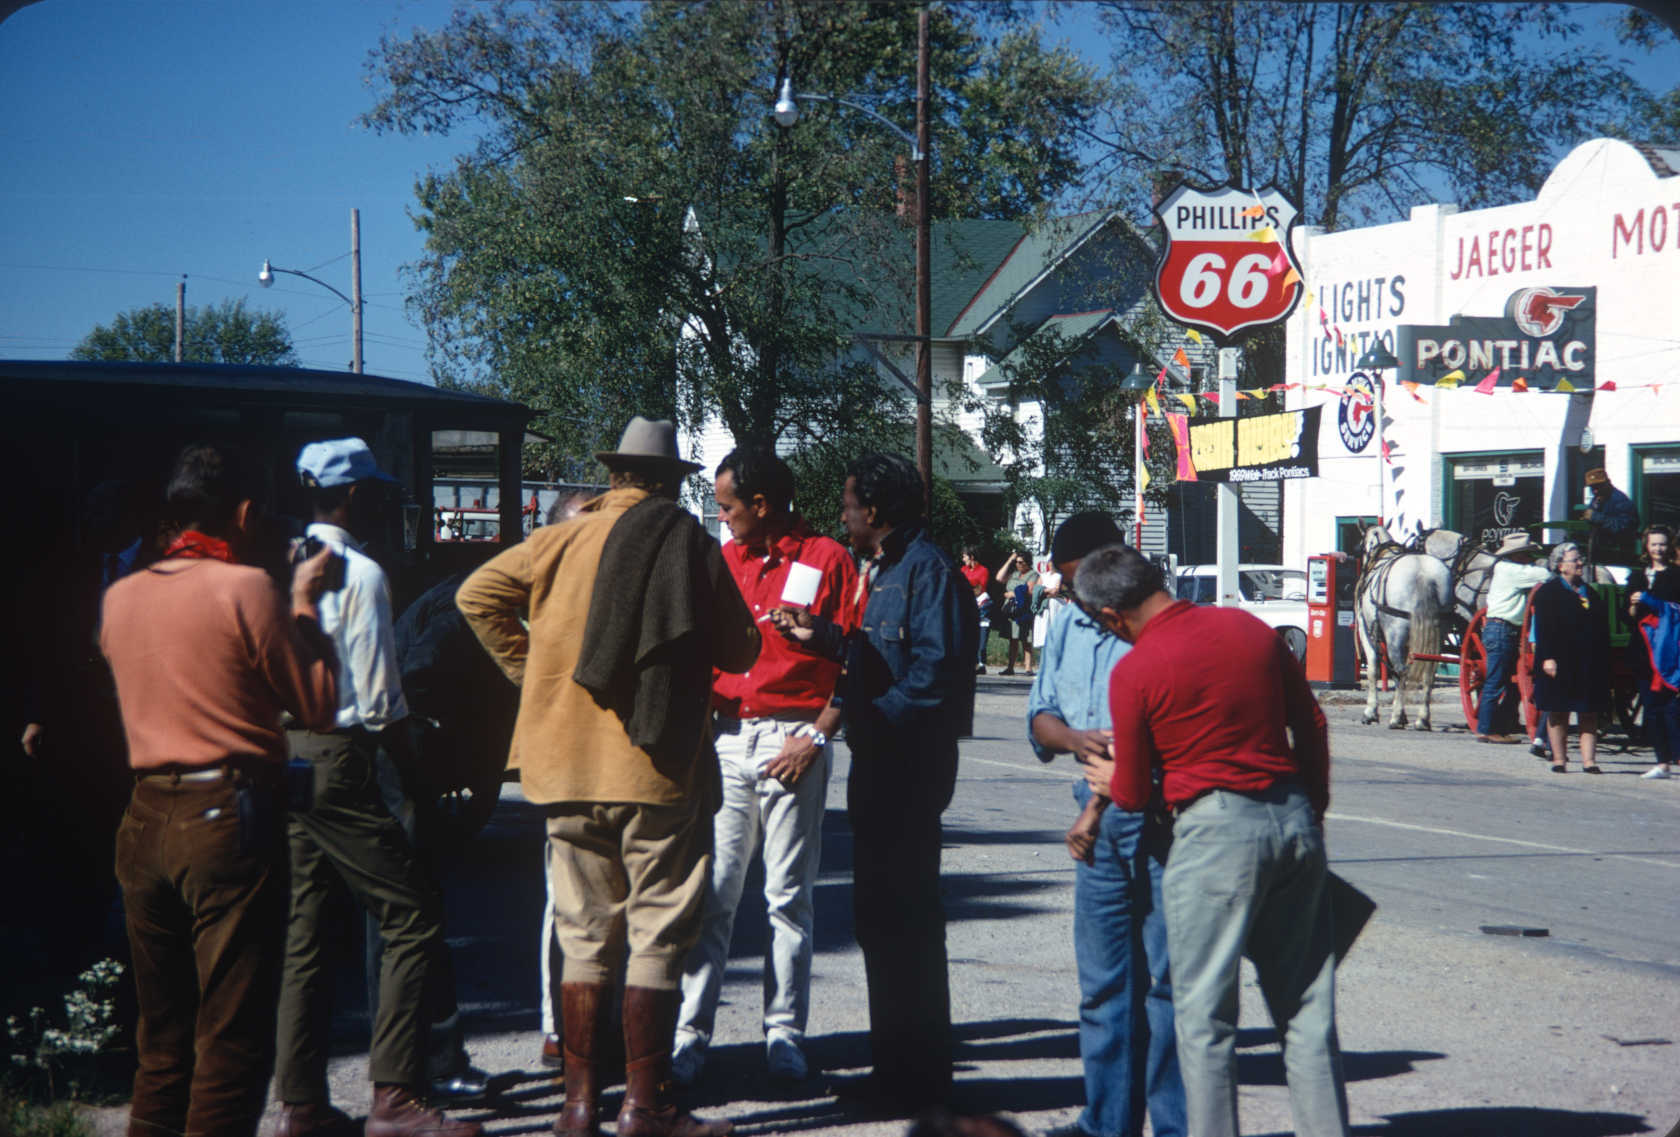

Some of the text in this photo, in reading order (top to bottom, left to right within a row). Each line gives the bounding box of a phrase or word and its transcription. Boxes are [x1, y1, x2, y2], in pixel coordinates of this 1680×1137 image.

[1177, 205, 1280, 230] PHILLIPS
[1450, 223, 1552, 280] JAEGER
[1179, 252, 1272, 309] 66
[1320, 274, 1406, 325] LIGHTS
[1417, 338, 1586, 371] PONTIAC
